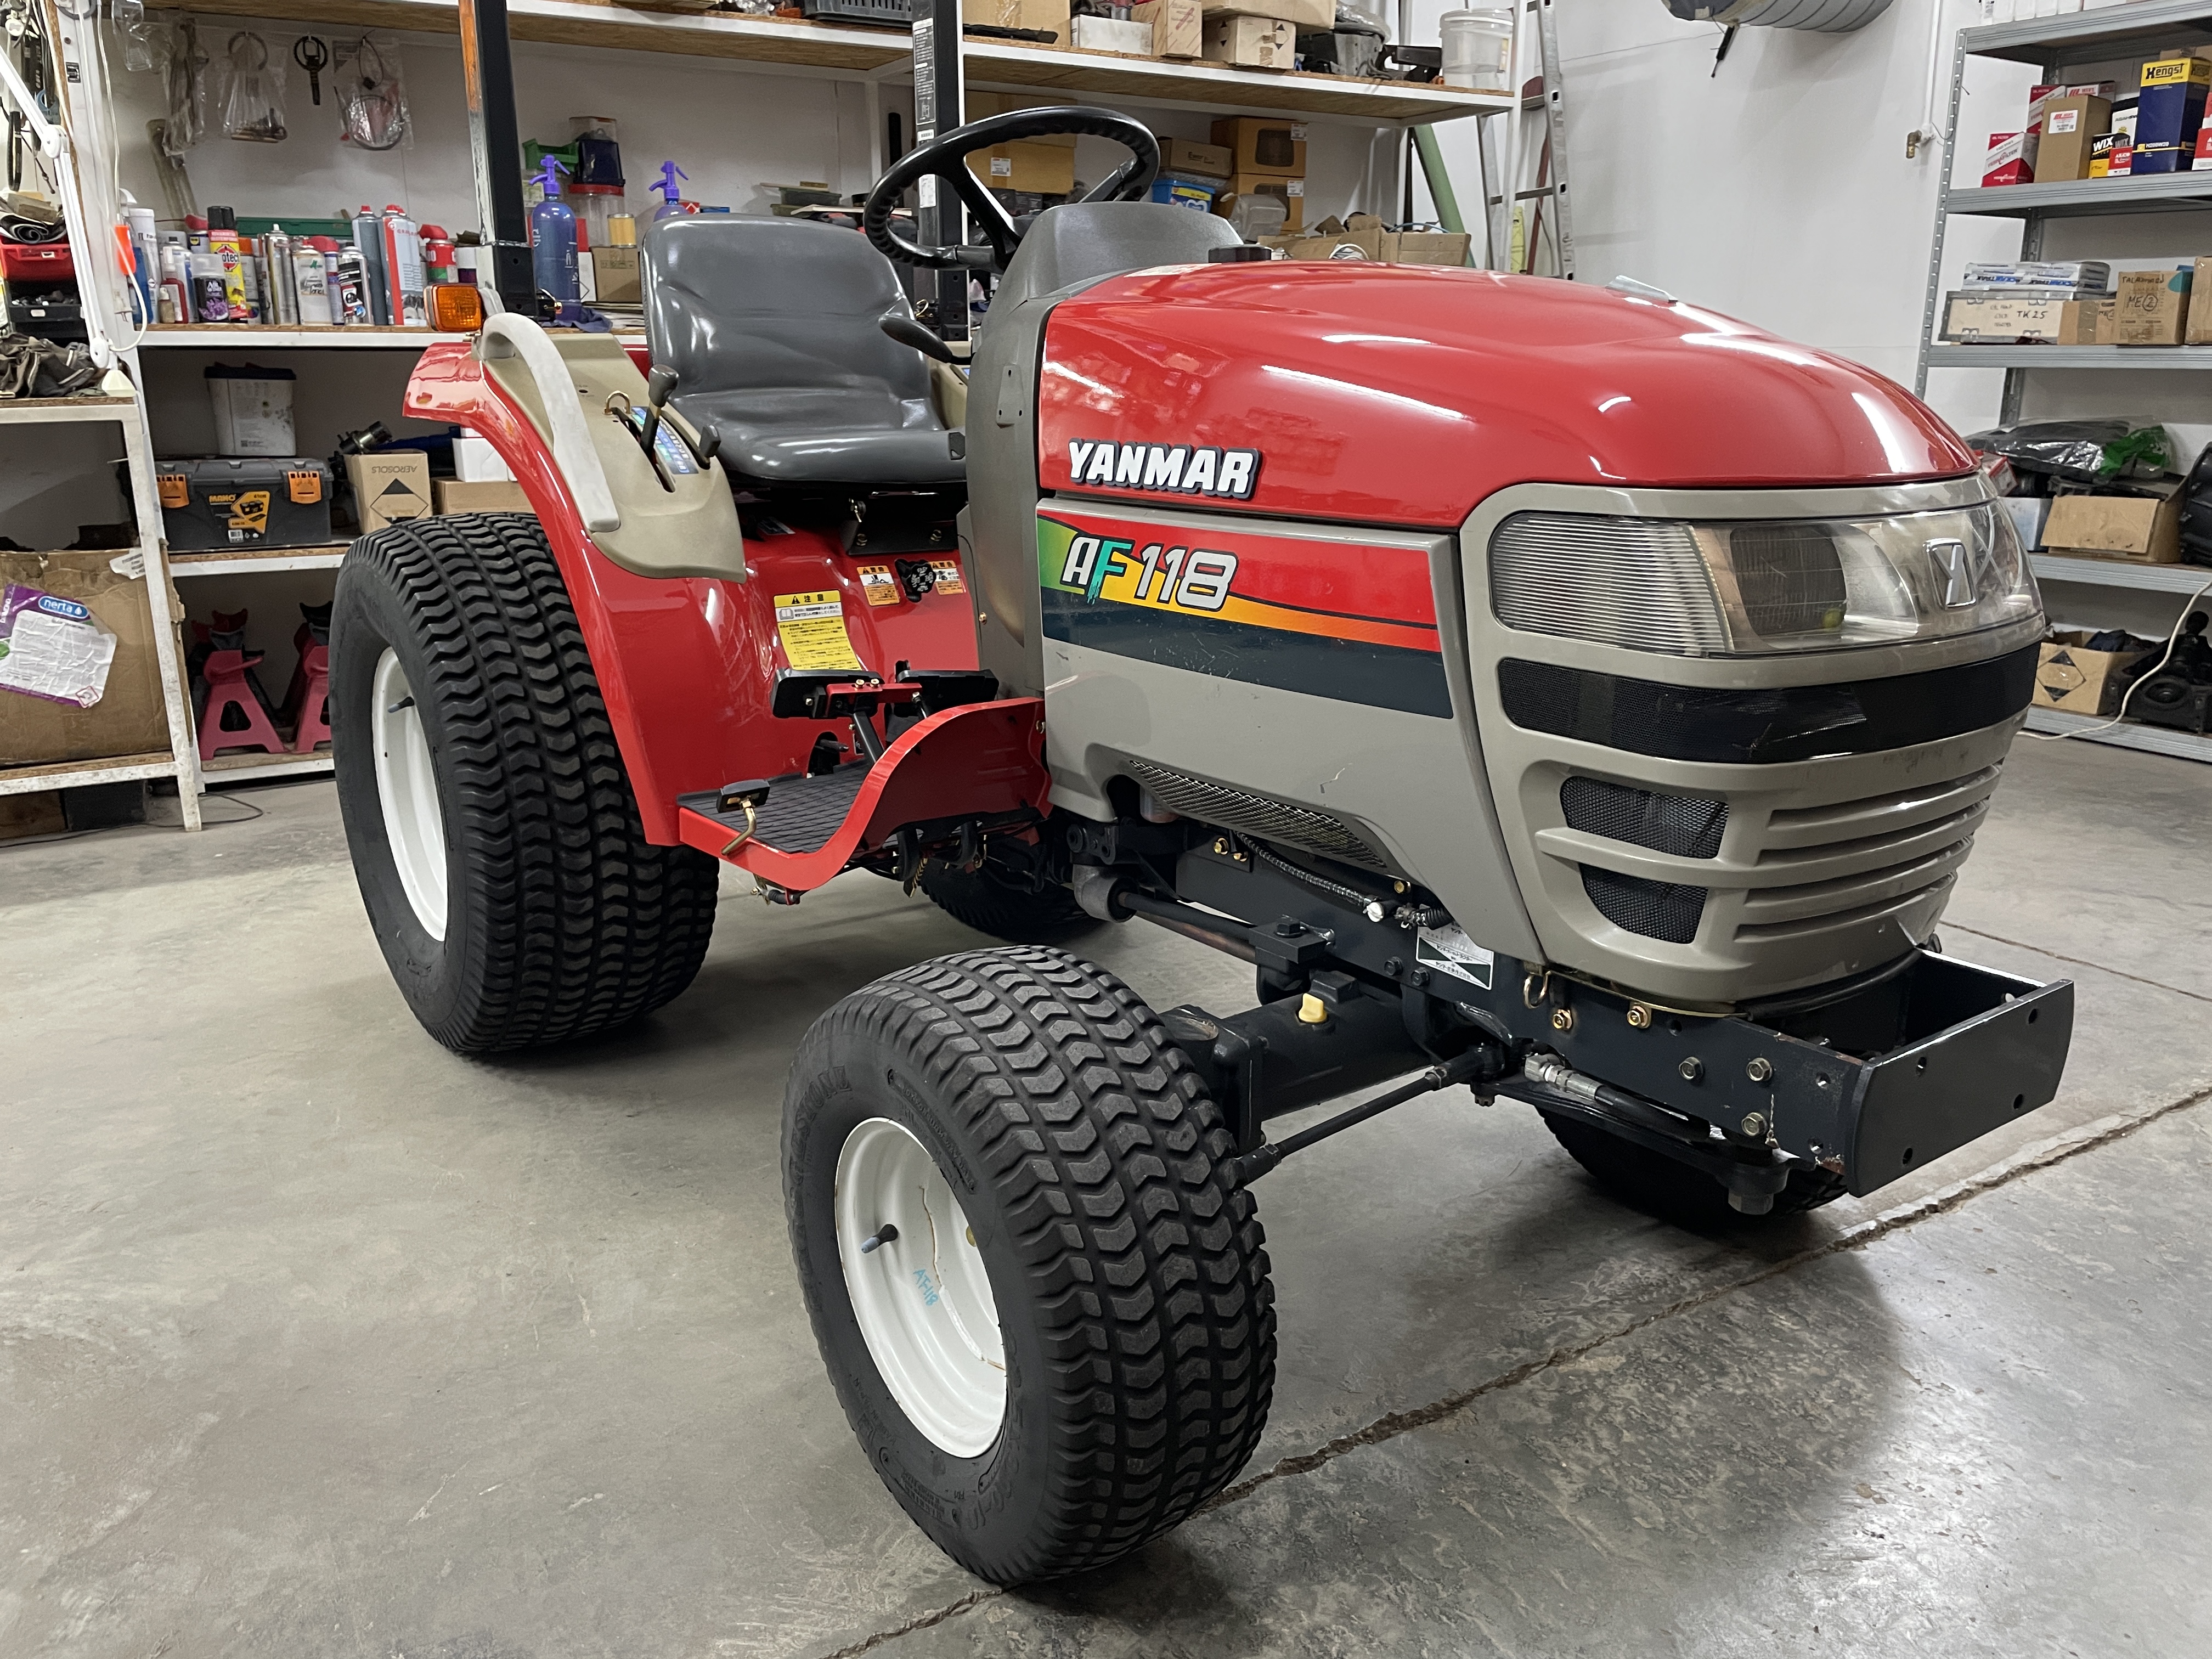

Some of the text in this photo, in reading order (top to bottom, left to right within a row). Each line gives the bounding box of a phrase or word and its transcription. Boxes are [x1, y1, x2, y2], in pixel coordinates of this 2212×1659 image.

[2145, 63, 2186, 80] Hengst
[2093, 136, 2114, 152] WIX
[2017, 311, 2048, 319] TK 25
[1069, 439, 1259, 498] YANMAR
[1061, 535, 1238, 611] AF118
[44, 599, 72, 613] nerta
